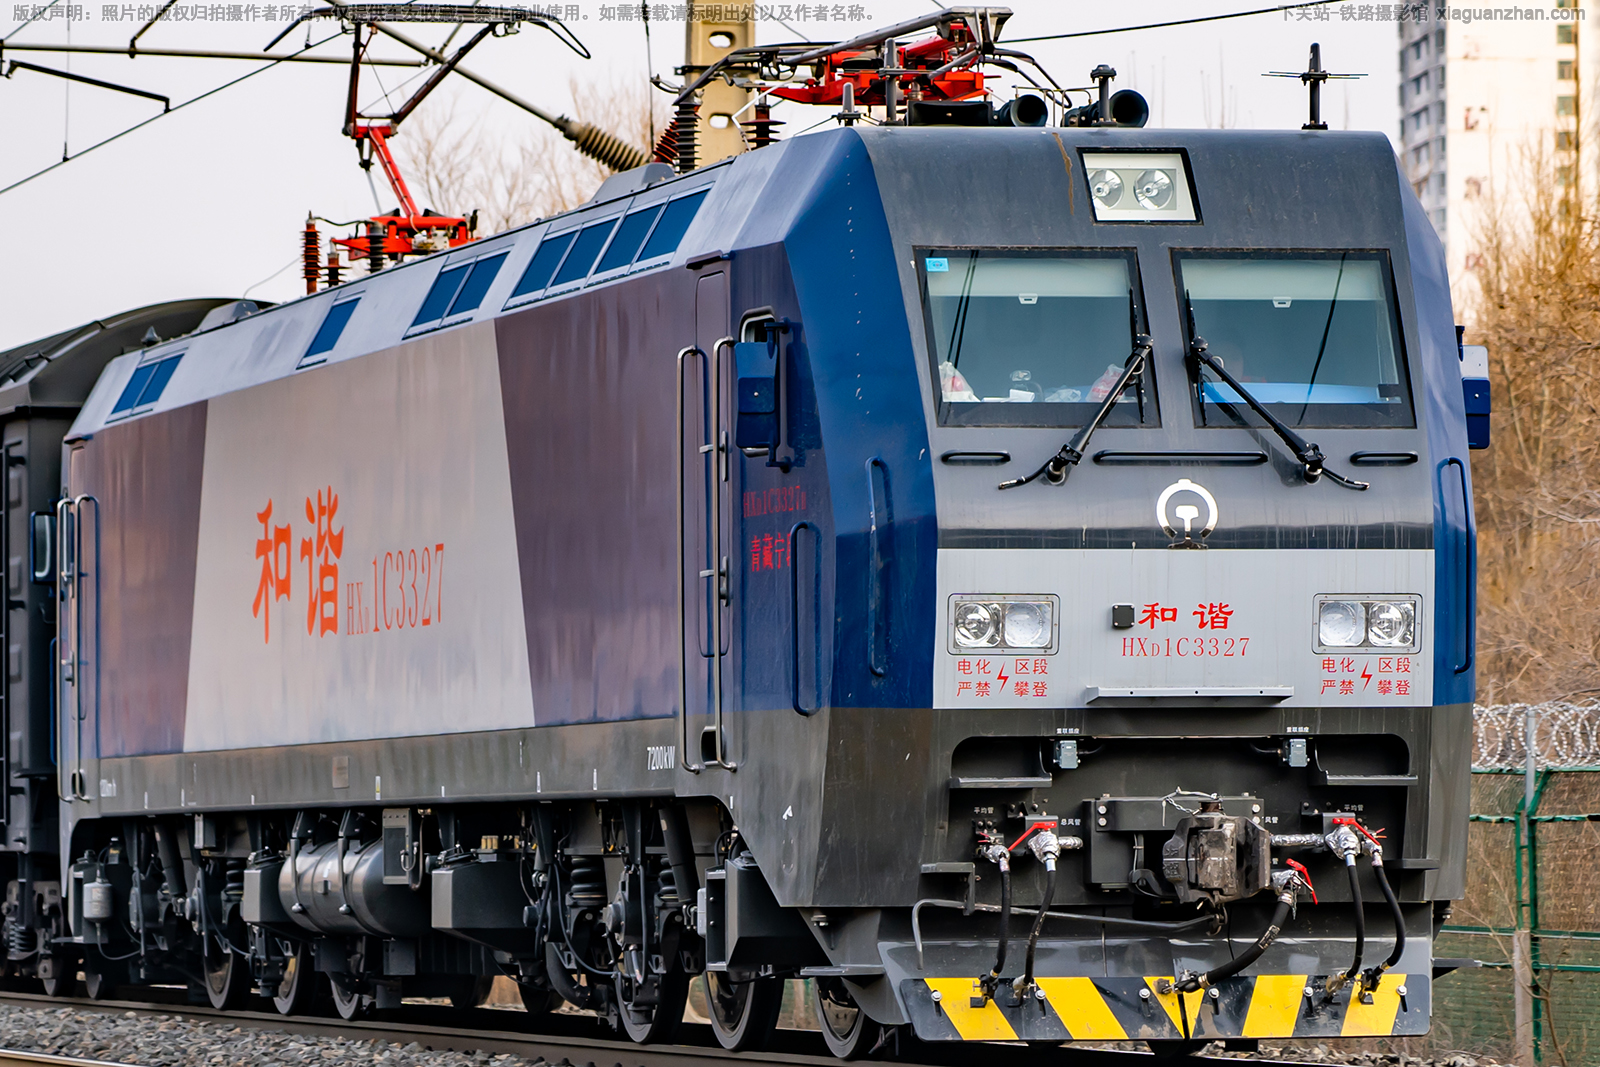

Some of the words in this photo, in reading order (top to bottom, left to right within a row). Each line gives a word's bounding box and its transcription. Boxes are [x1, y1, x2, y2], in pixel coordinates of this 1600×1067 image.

[252, 485, 344, 645] 和谐
[1138, 602, 1234, 630] 和谐
[957, 658, 991, 675] 电化
[1014, 658, 1048, 675] 区段
[1322, 656, 1355, 673] 电化
[1378, 657, 1411, 673] 区段
[956, 681, 991, 697] 严禁
[1013, 681, 1048, 697] 攀登
[1320, 679, 1354, 695] 严禁
[1377, 679, 1410, 695] 攀登
